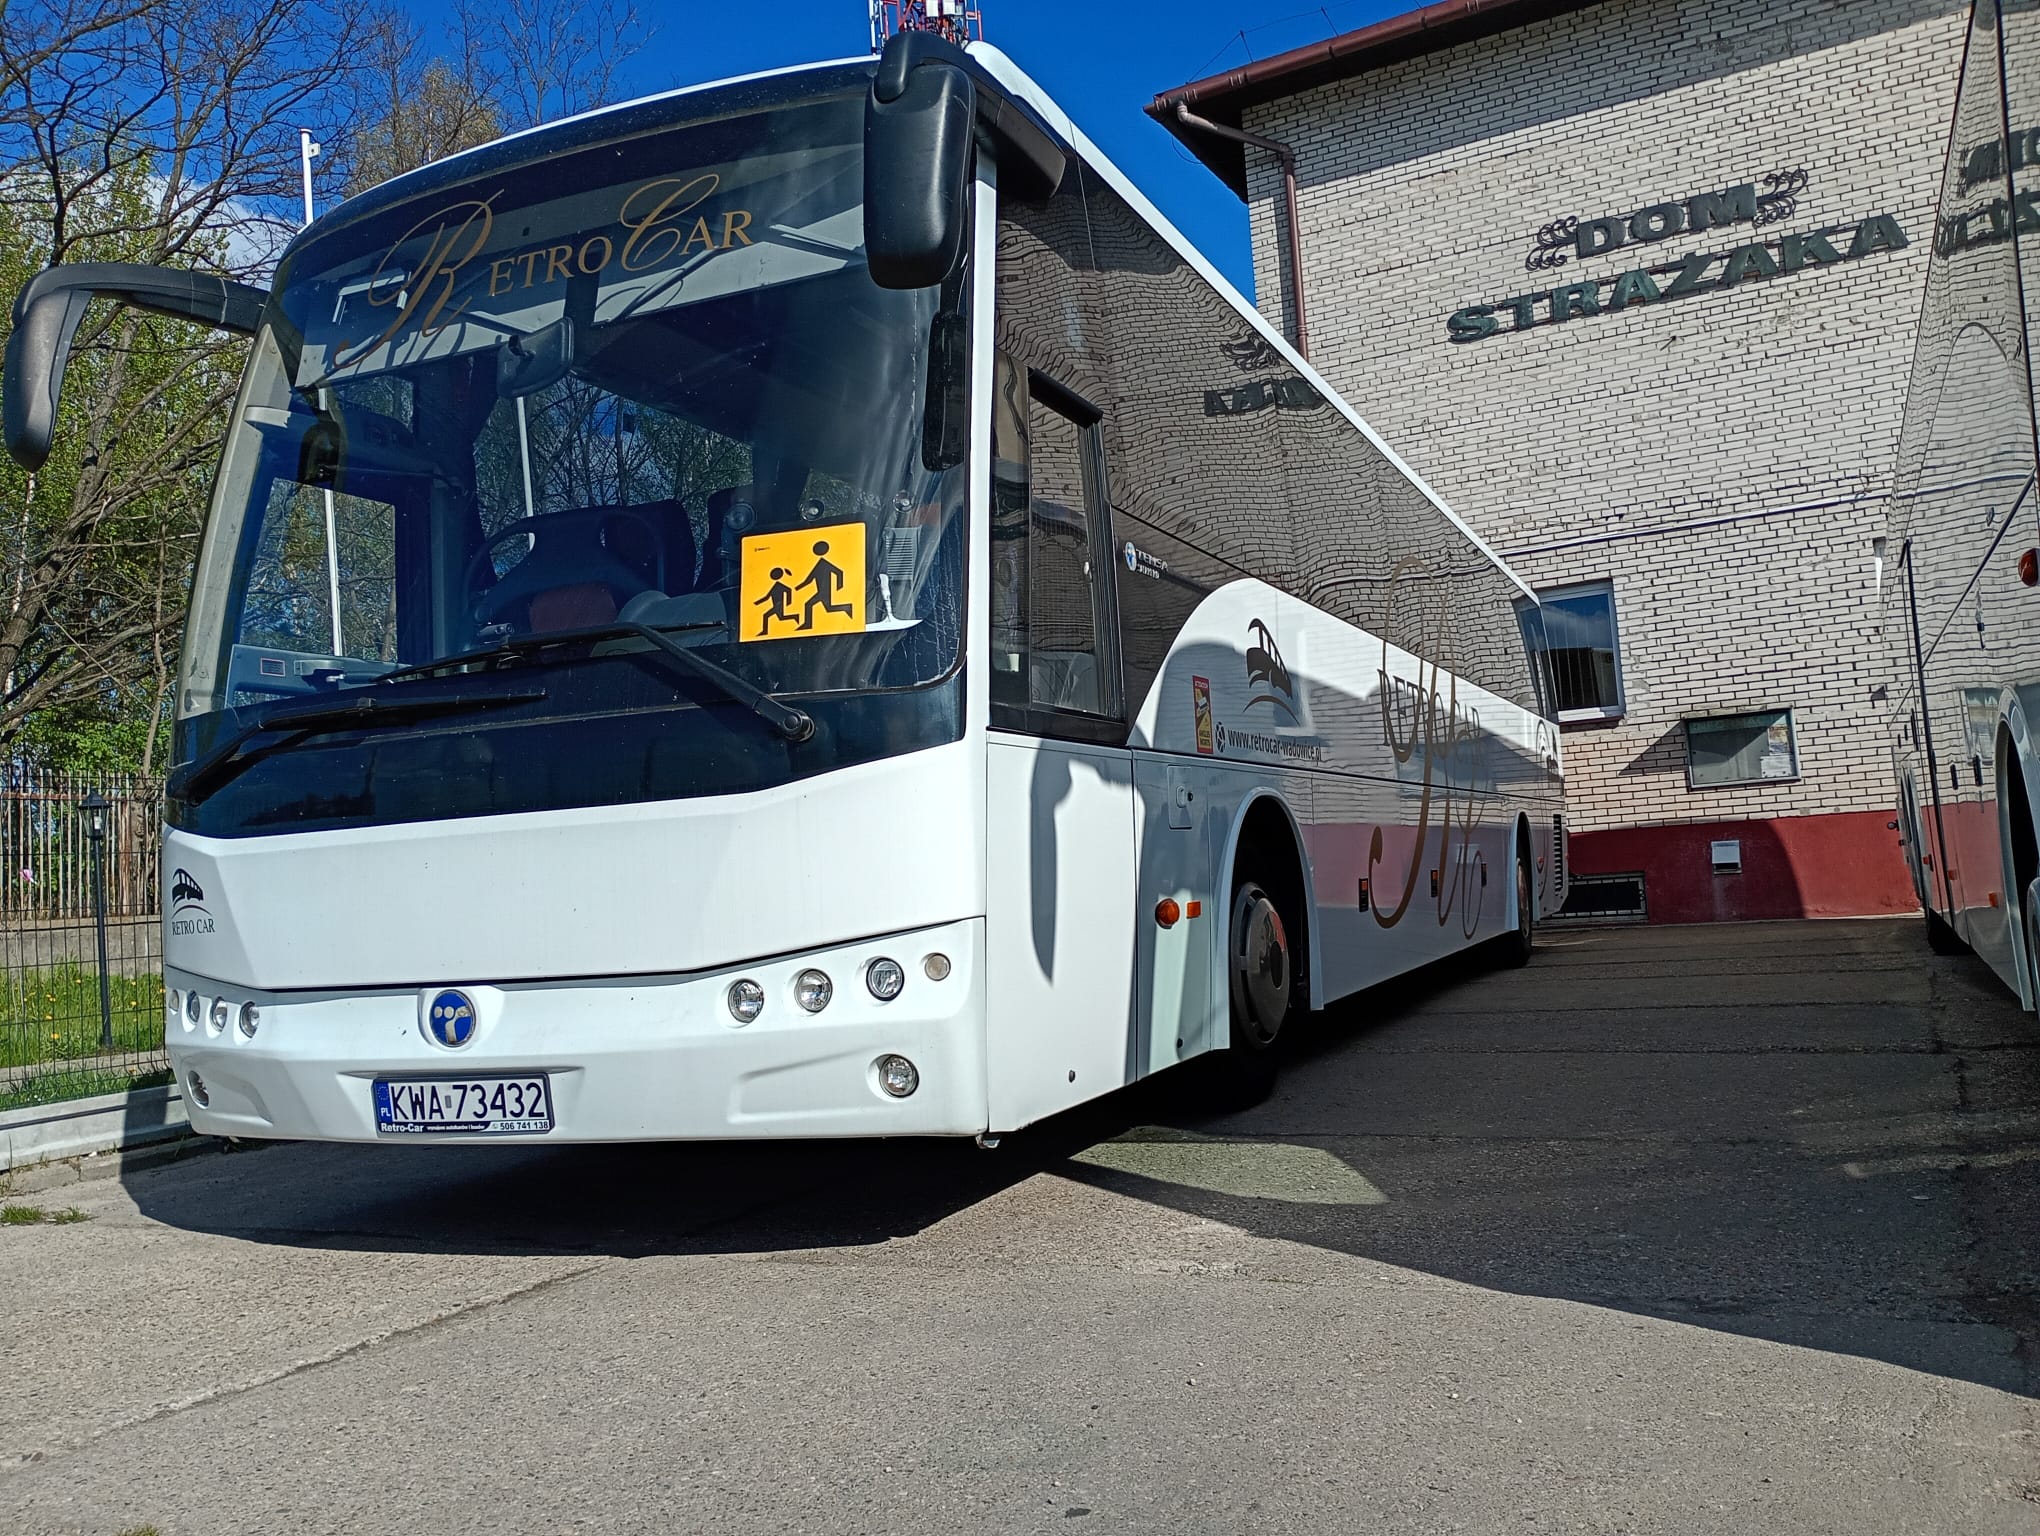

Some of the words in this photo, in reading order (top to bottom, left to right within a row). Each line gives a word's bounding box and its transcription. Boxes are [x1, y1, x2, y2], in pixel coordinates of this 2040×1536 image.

[1575, 182, 1757, 260] DOM
[1227, 729, 1322, 763] www.retrocar-wadowice.pl
[171, 919, 195, 936] RETRO
[196, 918, 216, 934] CAR
[380, 1107, 391, 1117] PL
[391, 1085, 445, 1120] KWA
[452, 1082, 545, 1119] 73432
[380, 1122, 424, 1133] Retro-Car
[500, 1122, 515, 1131] 506
[517, 1121, 531, 1130] 741
[534, 1121, 549, 1130] 138
